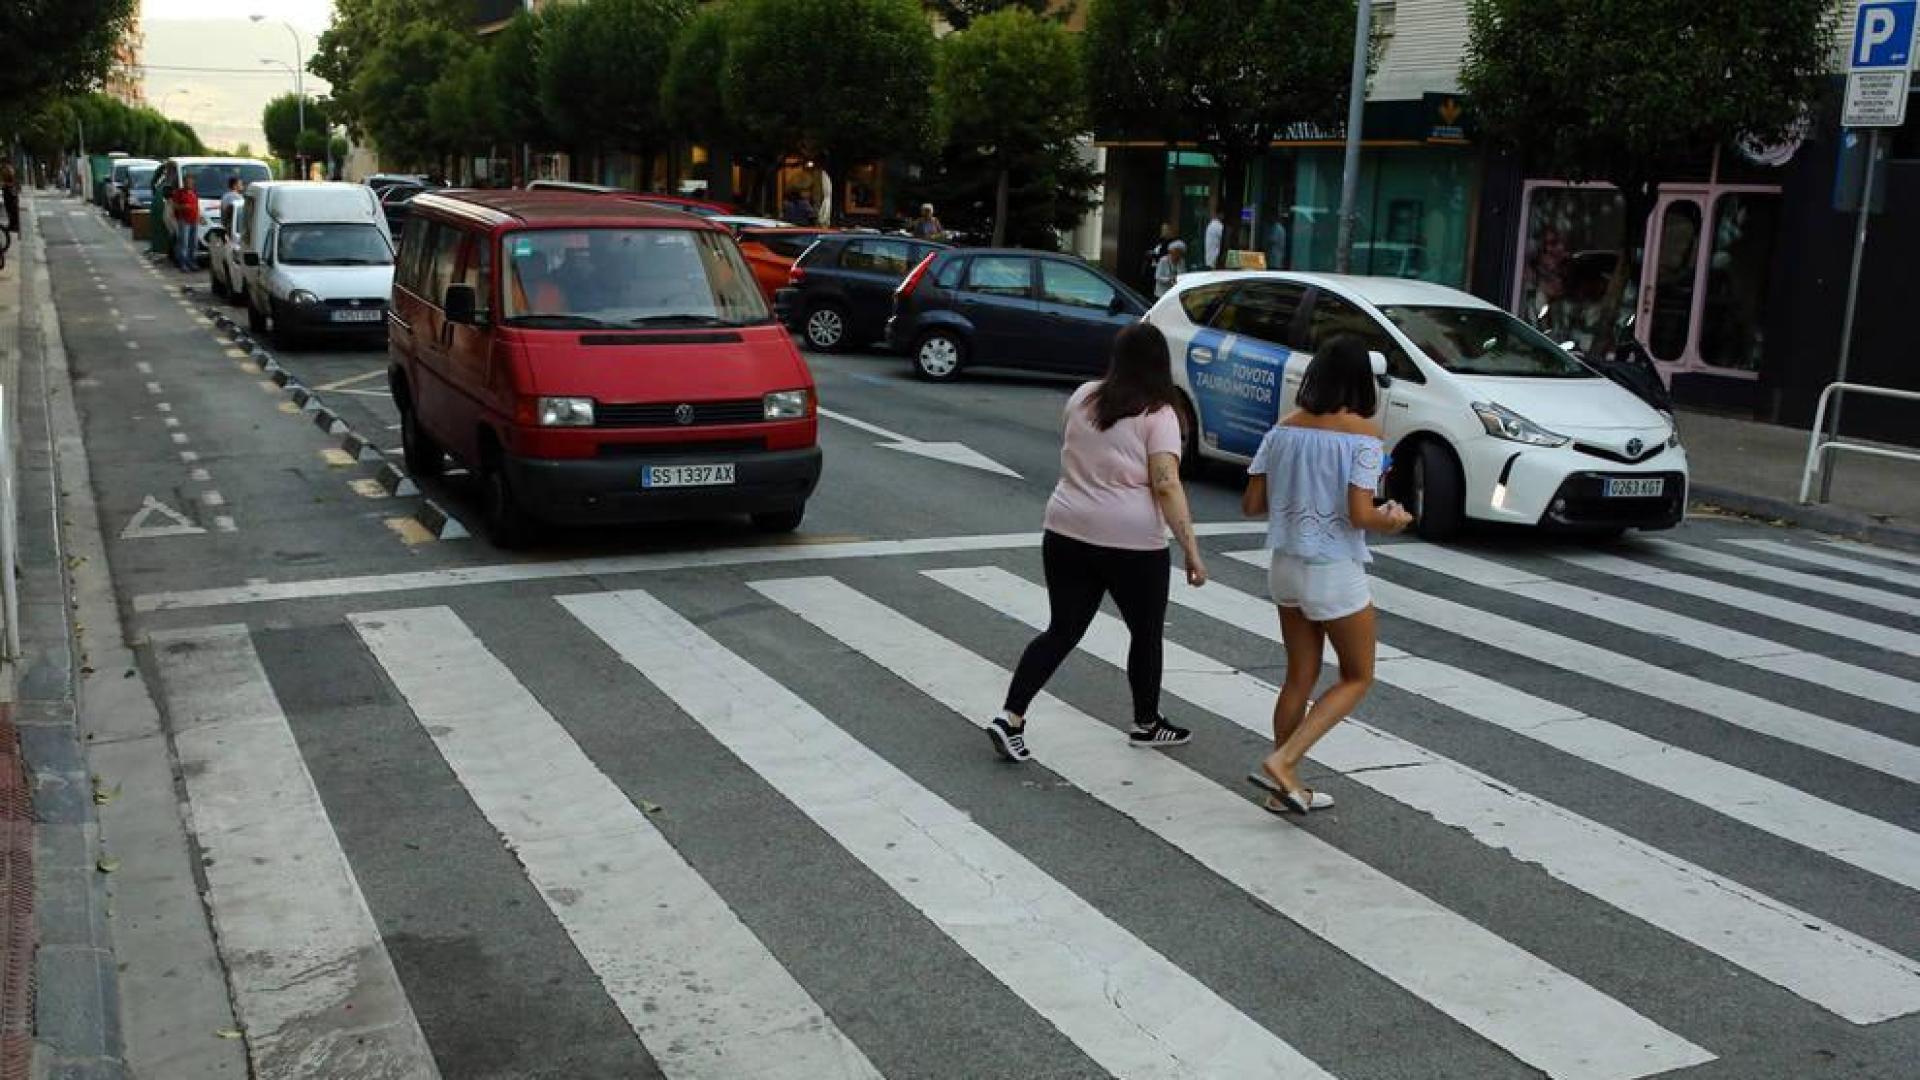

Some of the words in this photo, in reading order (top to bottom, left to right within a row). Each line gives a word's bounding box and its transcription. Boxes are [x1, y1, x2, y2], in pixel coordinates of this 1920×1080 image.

[1860, 8, 1895, 62] P
[1232, 363, 1275, 386] TOYOTA
[652, 469, 672, 484] SS
[677, 467, 713, 483] 1337
[715, 464, 733, 481] AX
